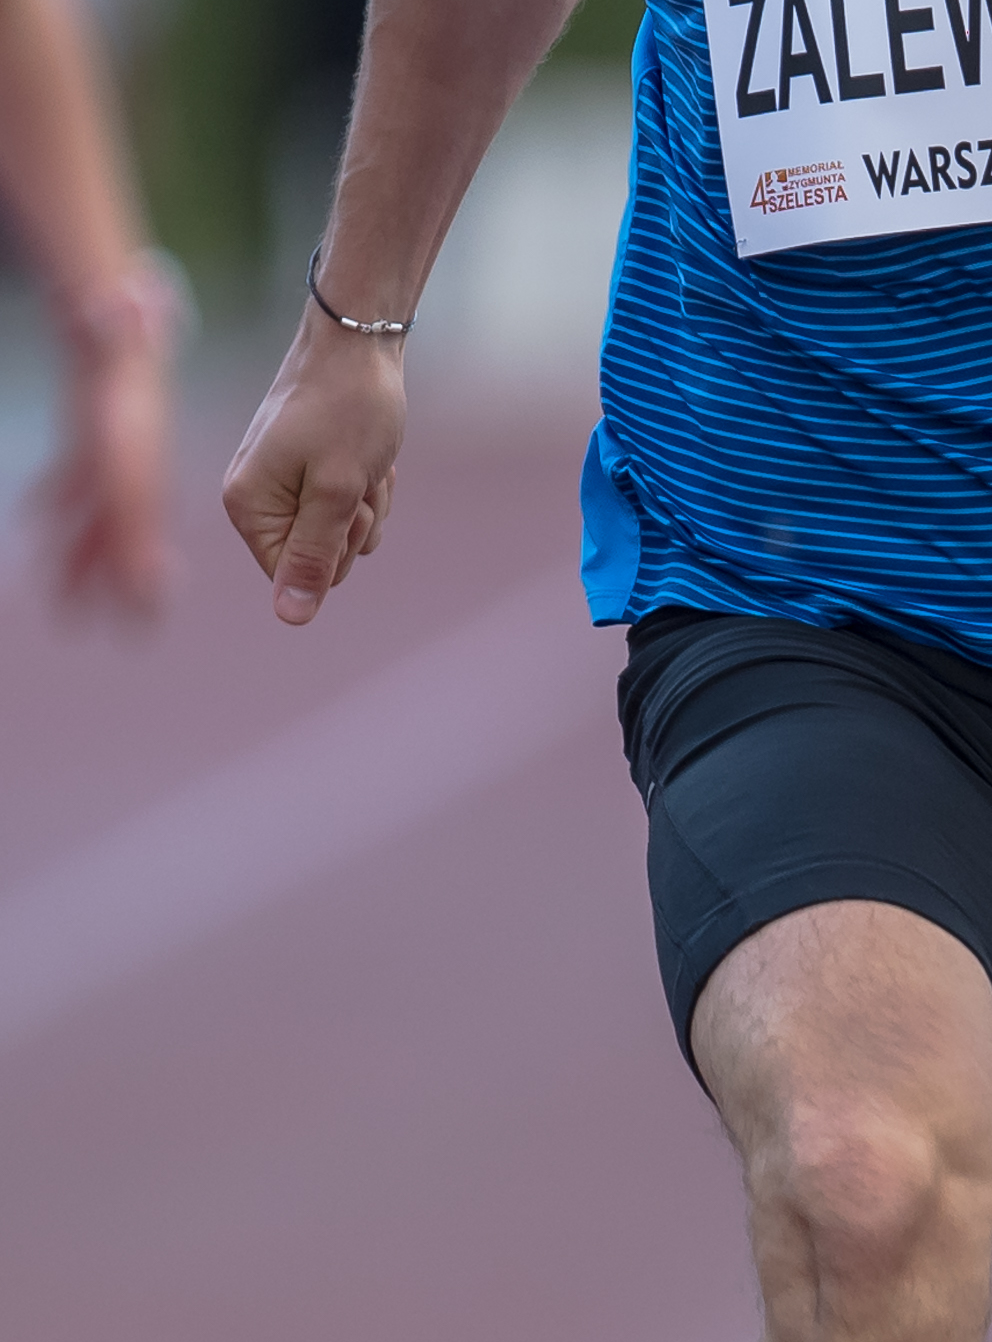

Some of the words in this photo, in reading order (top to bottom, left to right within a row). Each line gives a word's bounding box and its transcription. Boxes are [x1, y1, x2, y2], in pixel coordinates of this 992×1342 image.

[788, 160, 845, 177] MEMORIAŁ
[788, 173, 847, 190] ZYGMUNTA
[768, 185, 849, 213] SZELESTA
